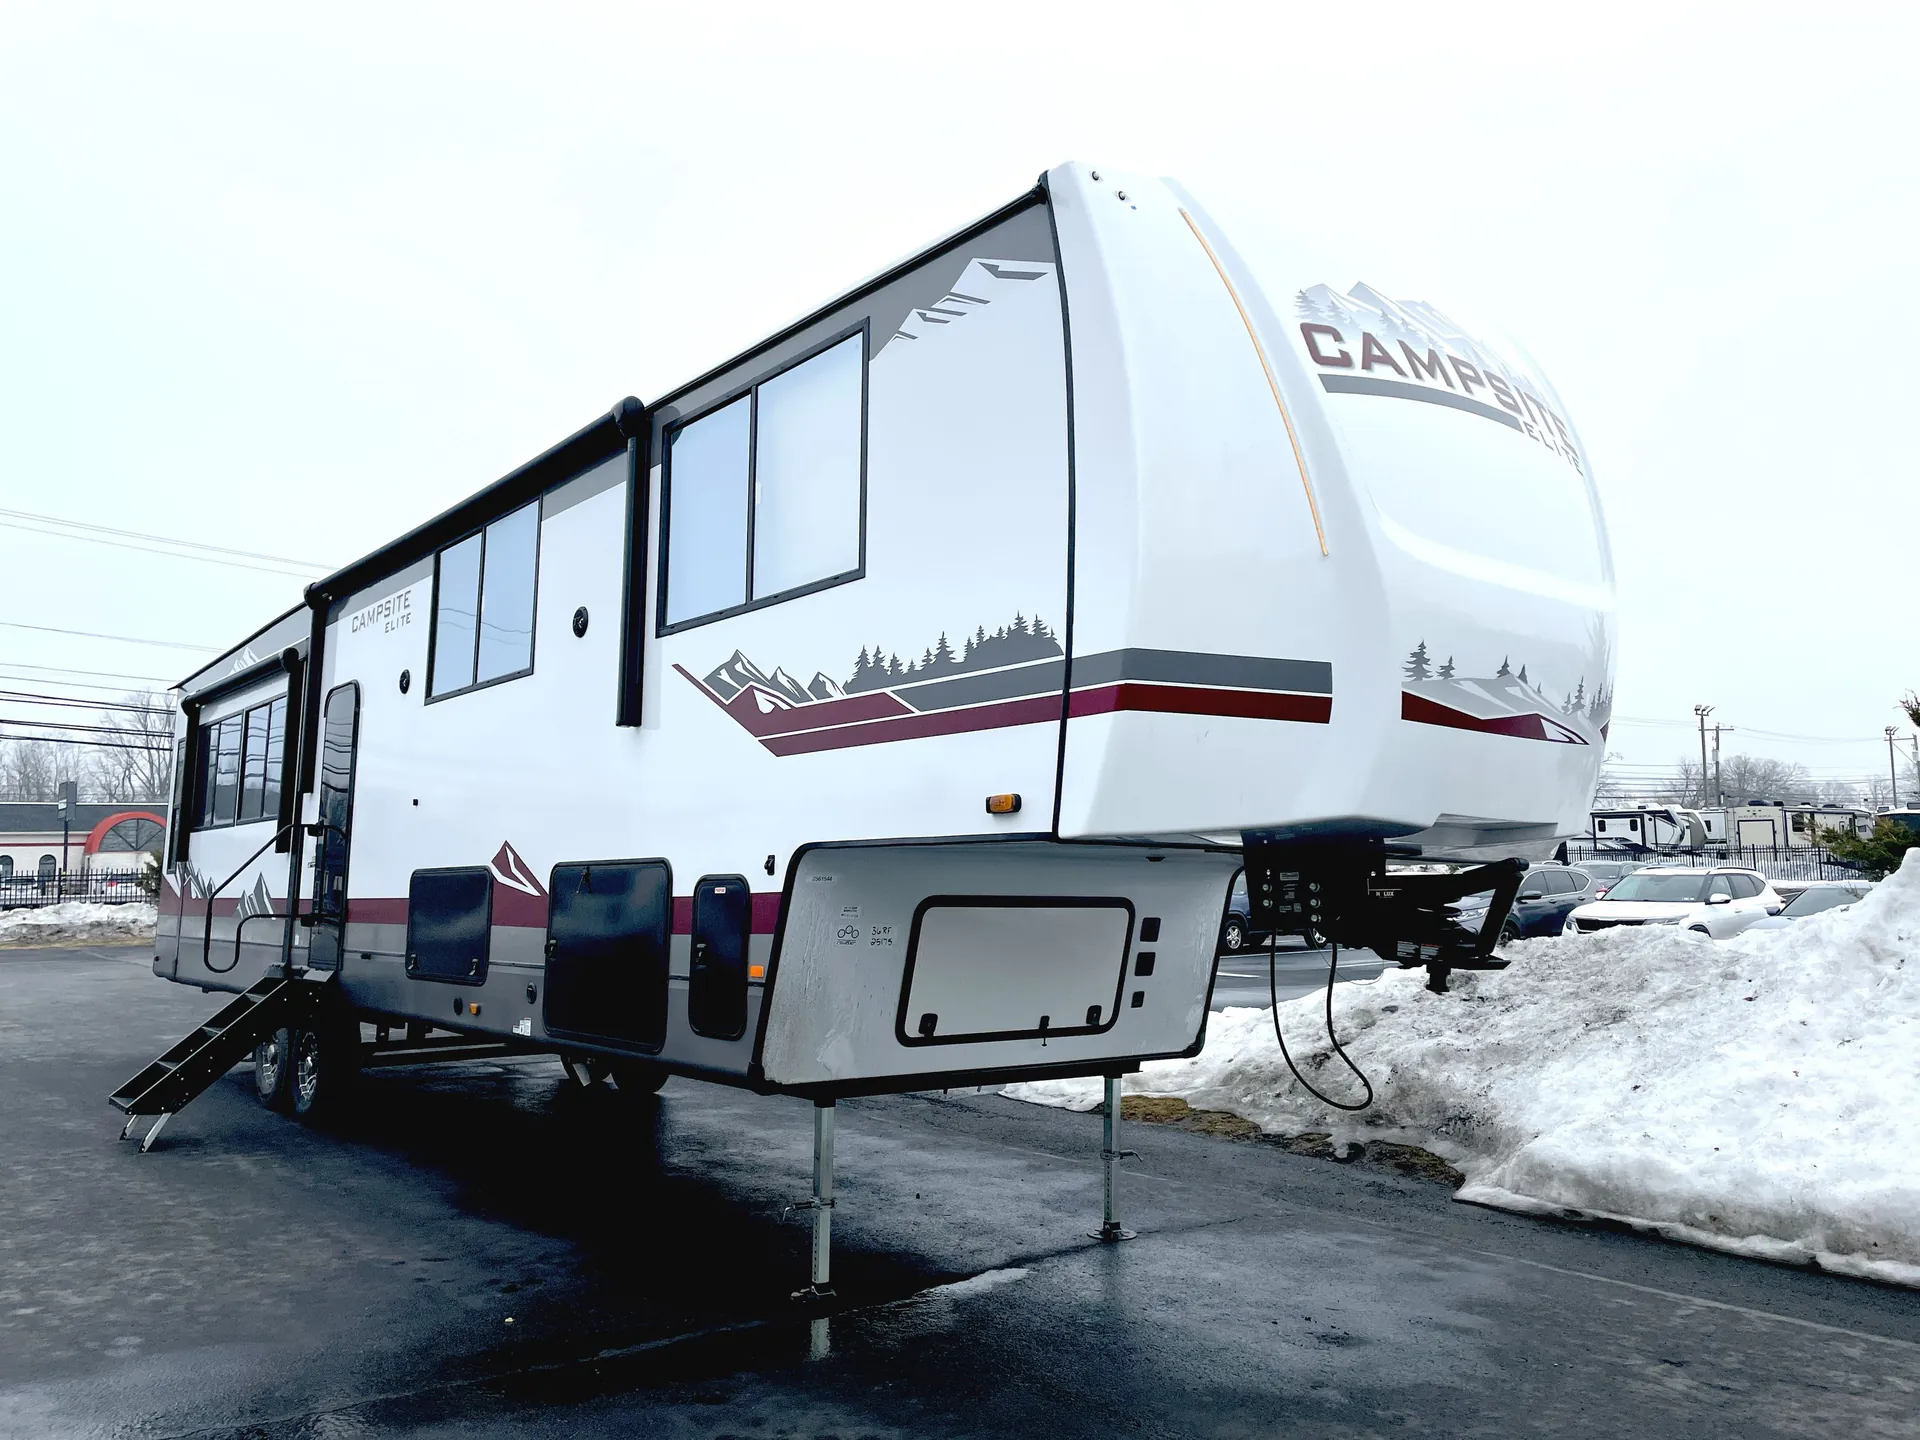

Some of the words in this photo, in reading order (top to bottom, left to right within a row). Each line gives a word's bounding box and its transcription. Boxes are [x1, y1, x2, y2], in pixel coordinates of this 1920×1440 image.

[1299, 322, 1580, 459] CAMPSITE
[1523, 421, 1584, 477] ELITE
[351, 590, 411, 633] CAMPSITE
[384, 612, 411, 633] ELITE
